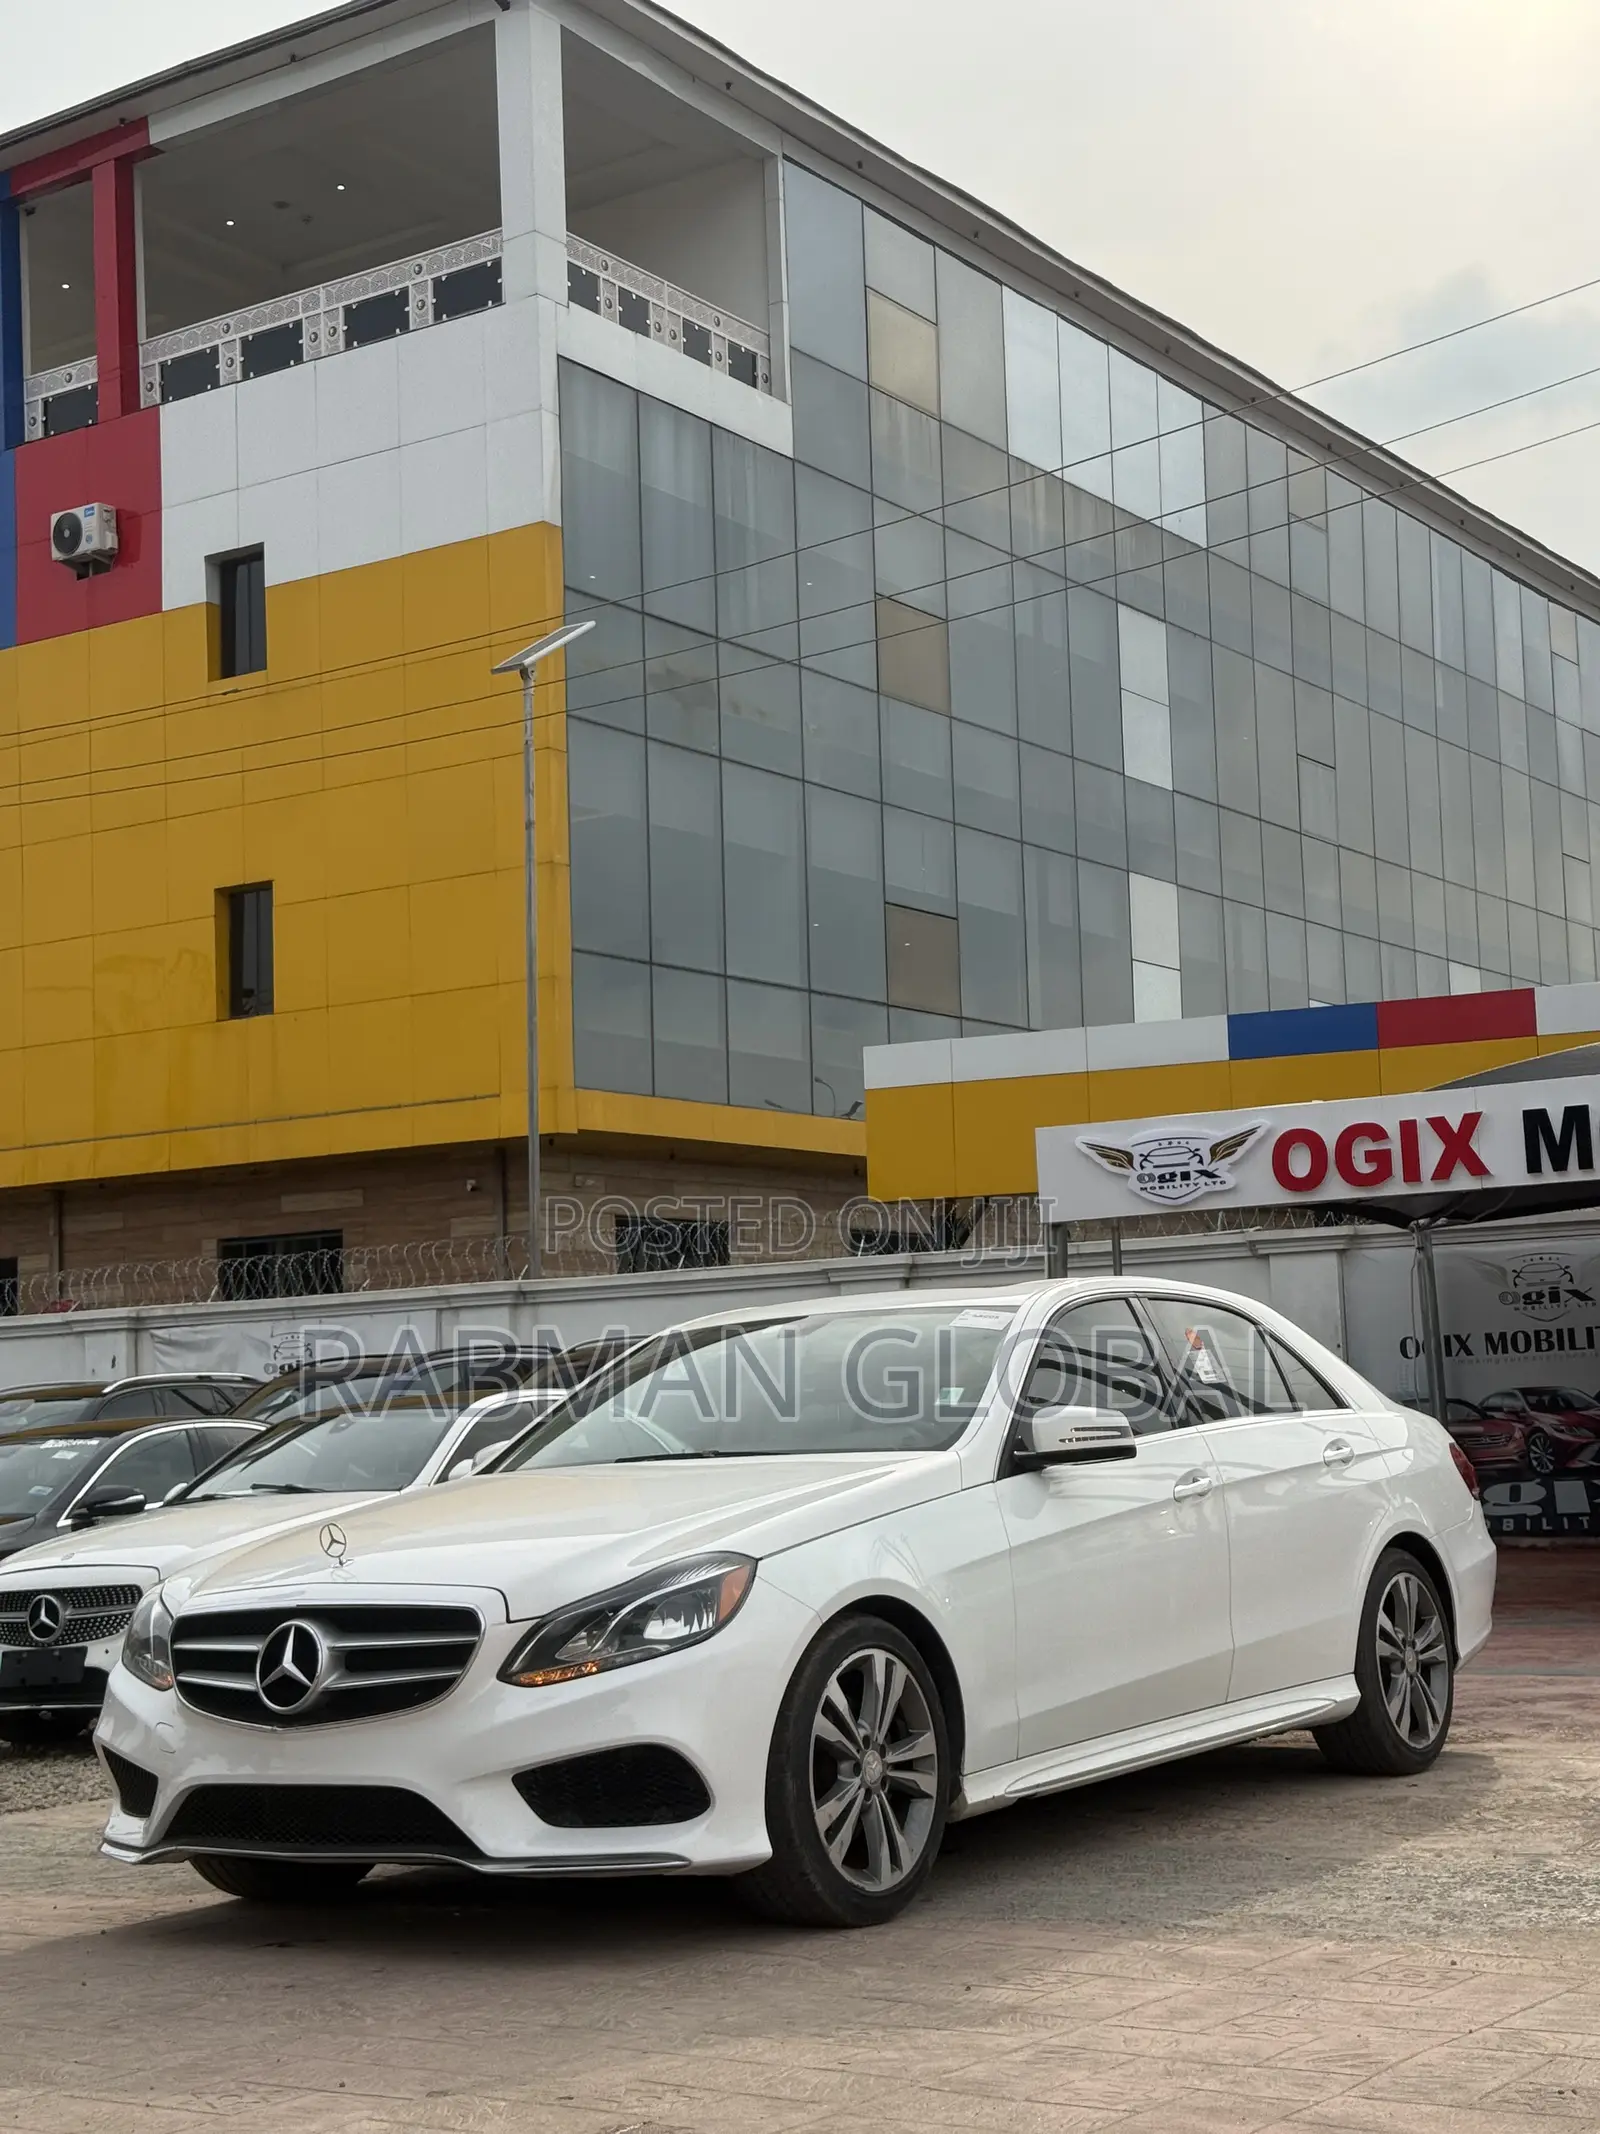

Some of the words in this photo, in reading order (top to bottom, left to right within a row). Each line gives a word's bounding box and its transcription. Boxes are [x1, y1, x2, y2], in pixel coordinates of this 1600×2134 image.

[1271, 1110, 1494, 1192] OGIX
[1139, 1182, 1200, 1191] MOBILITY
[1204, 1179, 1227, 1187] LTD
[1399, 1332, 1475, 1360] OIX
[1484, 1326, 1600, 1356] MOBILI
